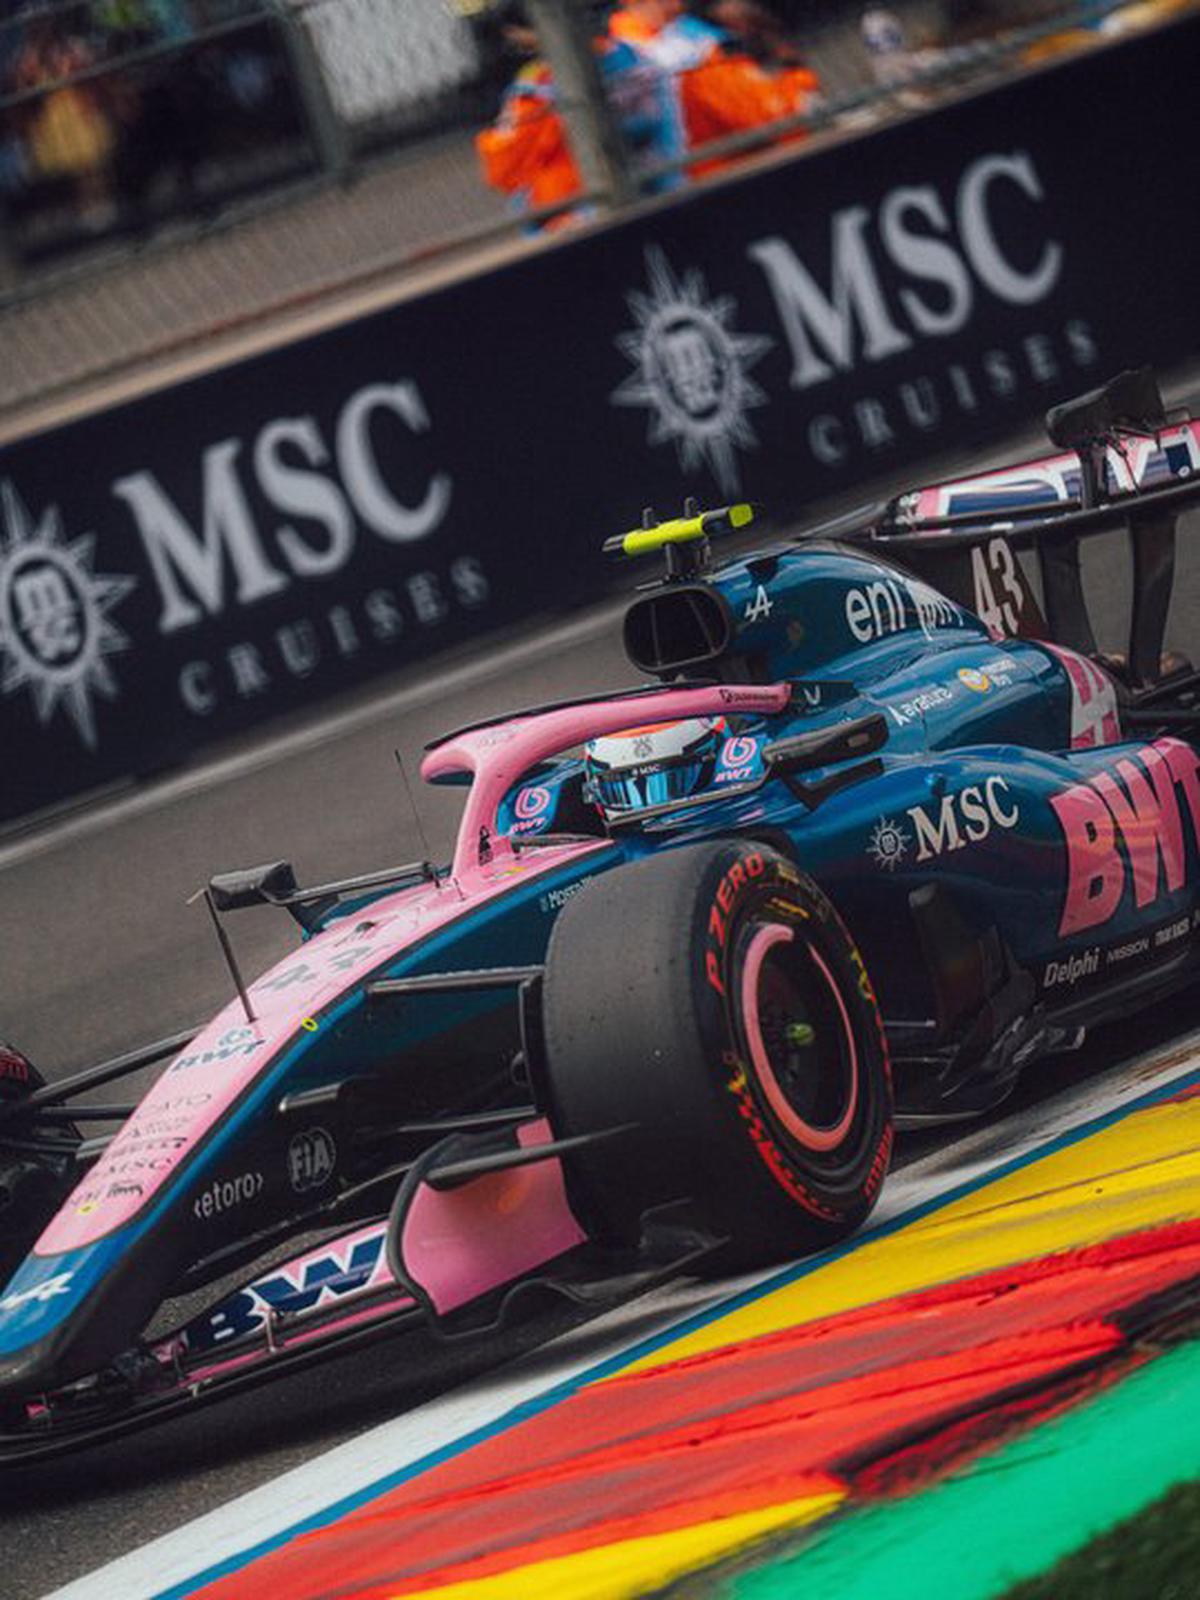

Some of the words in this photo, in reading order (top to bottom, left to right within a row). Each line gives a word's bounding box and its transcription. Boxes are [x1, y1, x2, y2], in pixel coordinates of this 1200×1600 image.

[748, 151, 1062, 390] MSC
[806, 318, 1098, 465] CRUISES
[111, 379, 452, 635] MSC
[178, 555, 490, 715] CRUISES
[845, 579, 906, 642] eni
[971, 537, 1023, 640] 43
[906, 775, 1019, 861] MSC
[708, 852, 765, 947] ZERO
[705, 951, 725, 998] P
[1043, 946, 1101, 988] Delphi
[184, 1233, 388, 1347] BW
